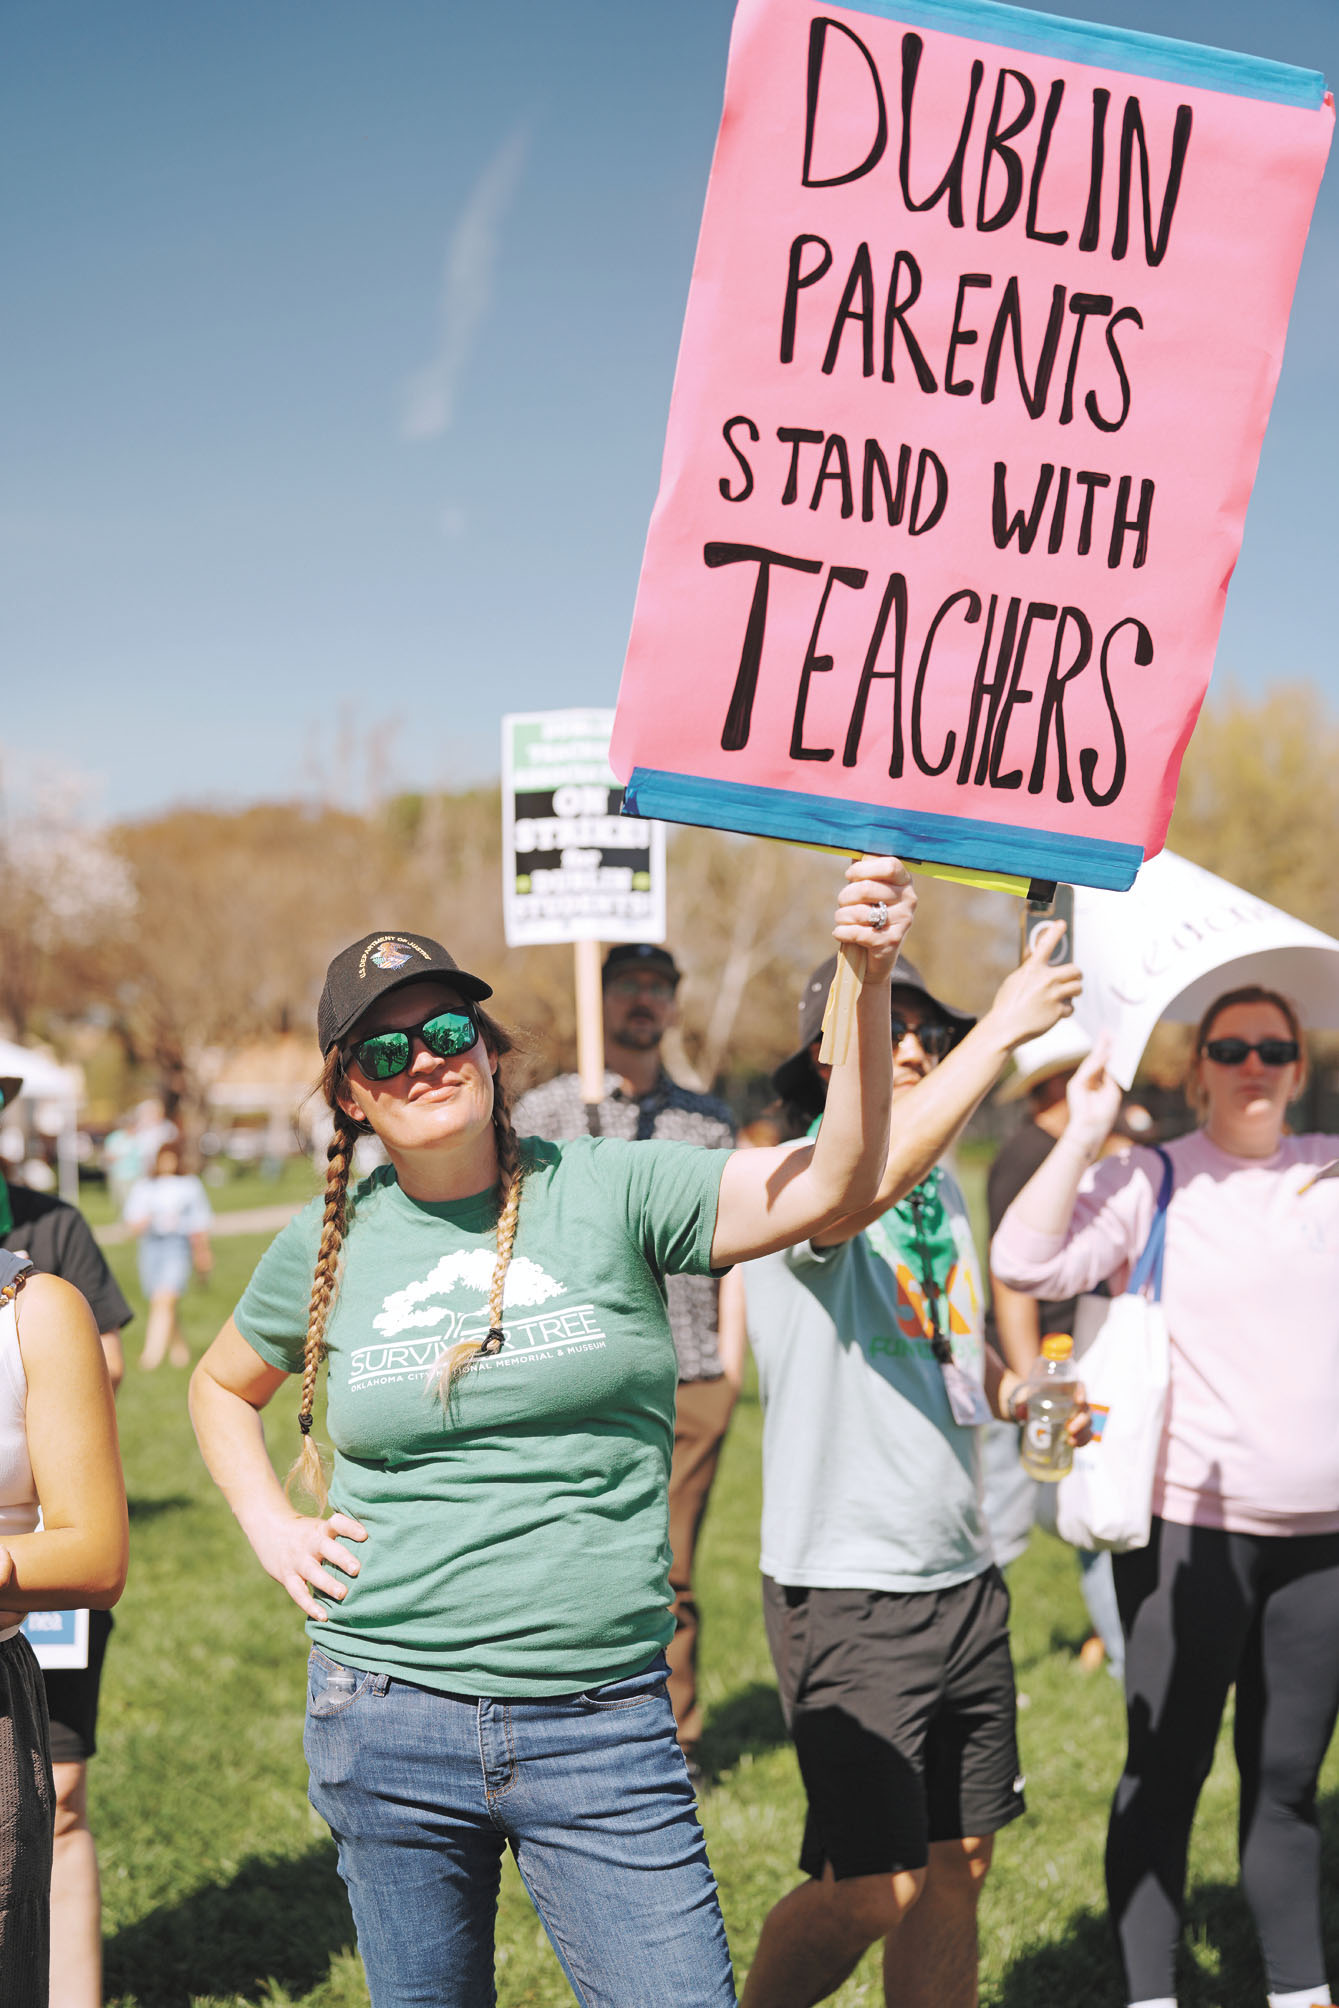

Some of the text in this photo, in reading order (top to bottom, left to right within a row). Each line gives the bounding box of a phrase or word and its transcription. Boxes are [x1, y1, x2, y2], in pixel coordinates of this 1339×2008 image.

[801, 16, 1194, 267] DUBLIN
[779, 233, 1144, 432] PARENTS
[718, 415, 1155, 569] STAND WITH
[703, 541, 1154, 807] TEACHERS
[552, 785, 609, 818] ON
[358, 935, 396, 968] DEPARTMENT
[397, 936, 408, 944] OF
[407, 941, 432, 961] JUSTICE
[351, 1375, 404, 1393] OKLAHOMA
[436, 1362, 493, 1377] NTIONAL
[495, 1351, 554, 1367] MEMORIAL
[557, 1349, 565, 1357] &
[567, 1341, 607, 1355] MUSEUM
[518, 1311, 601, 1345] TREE
